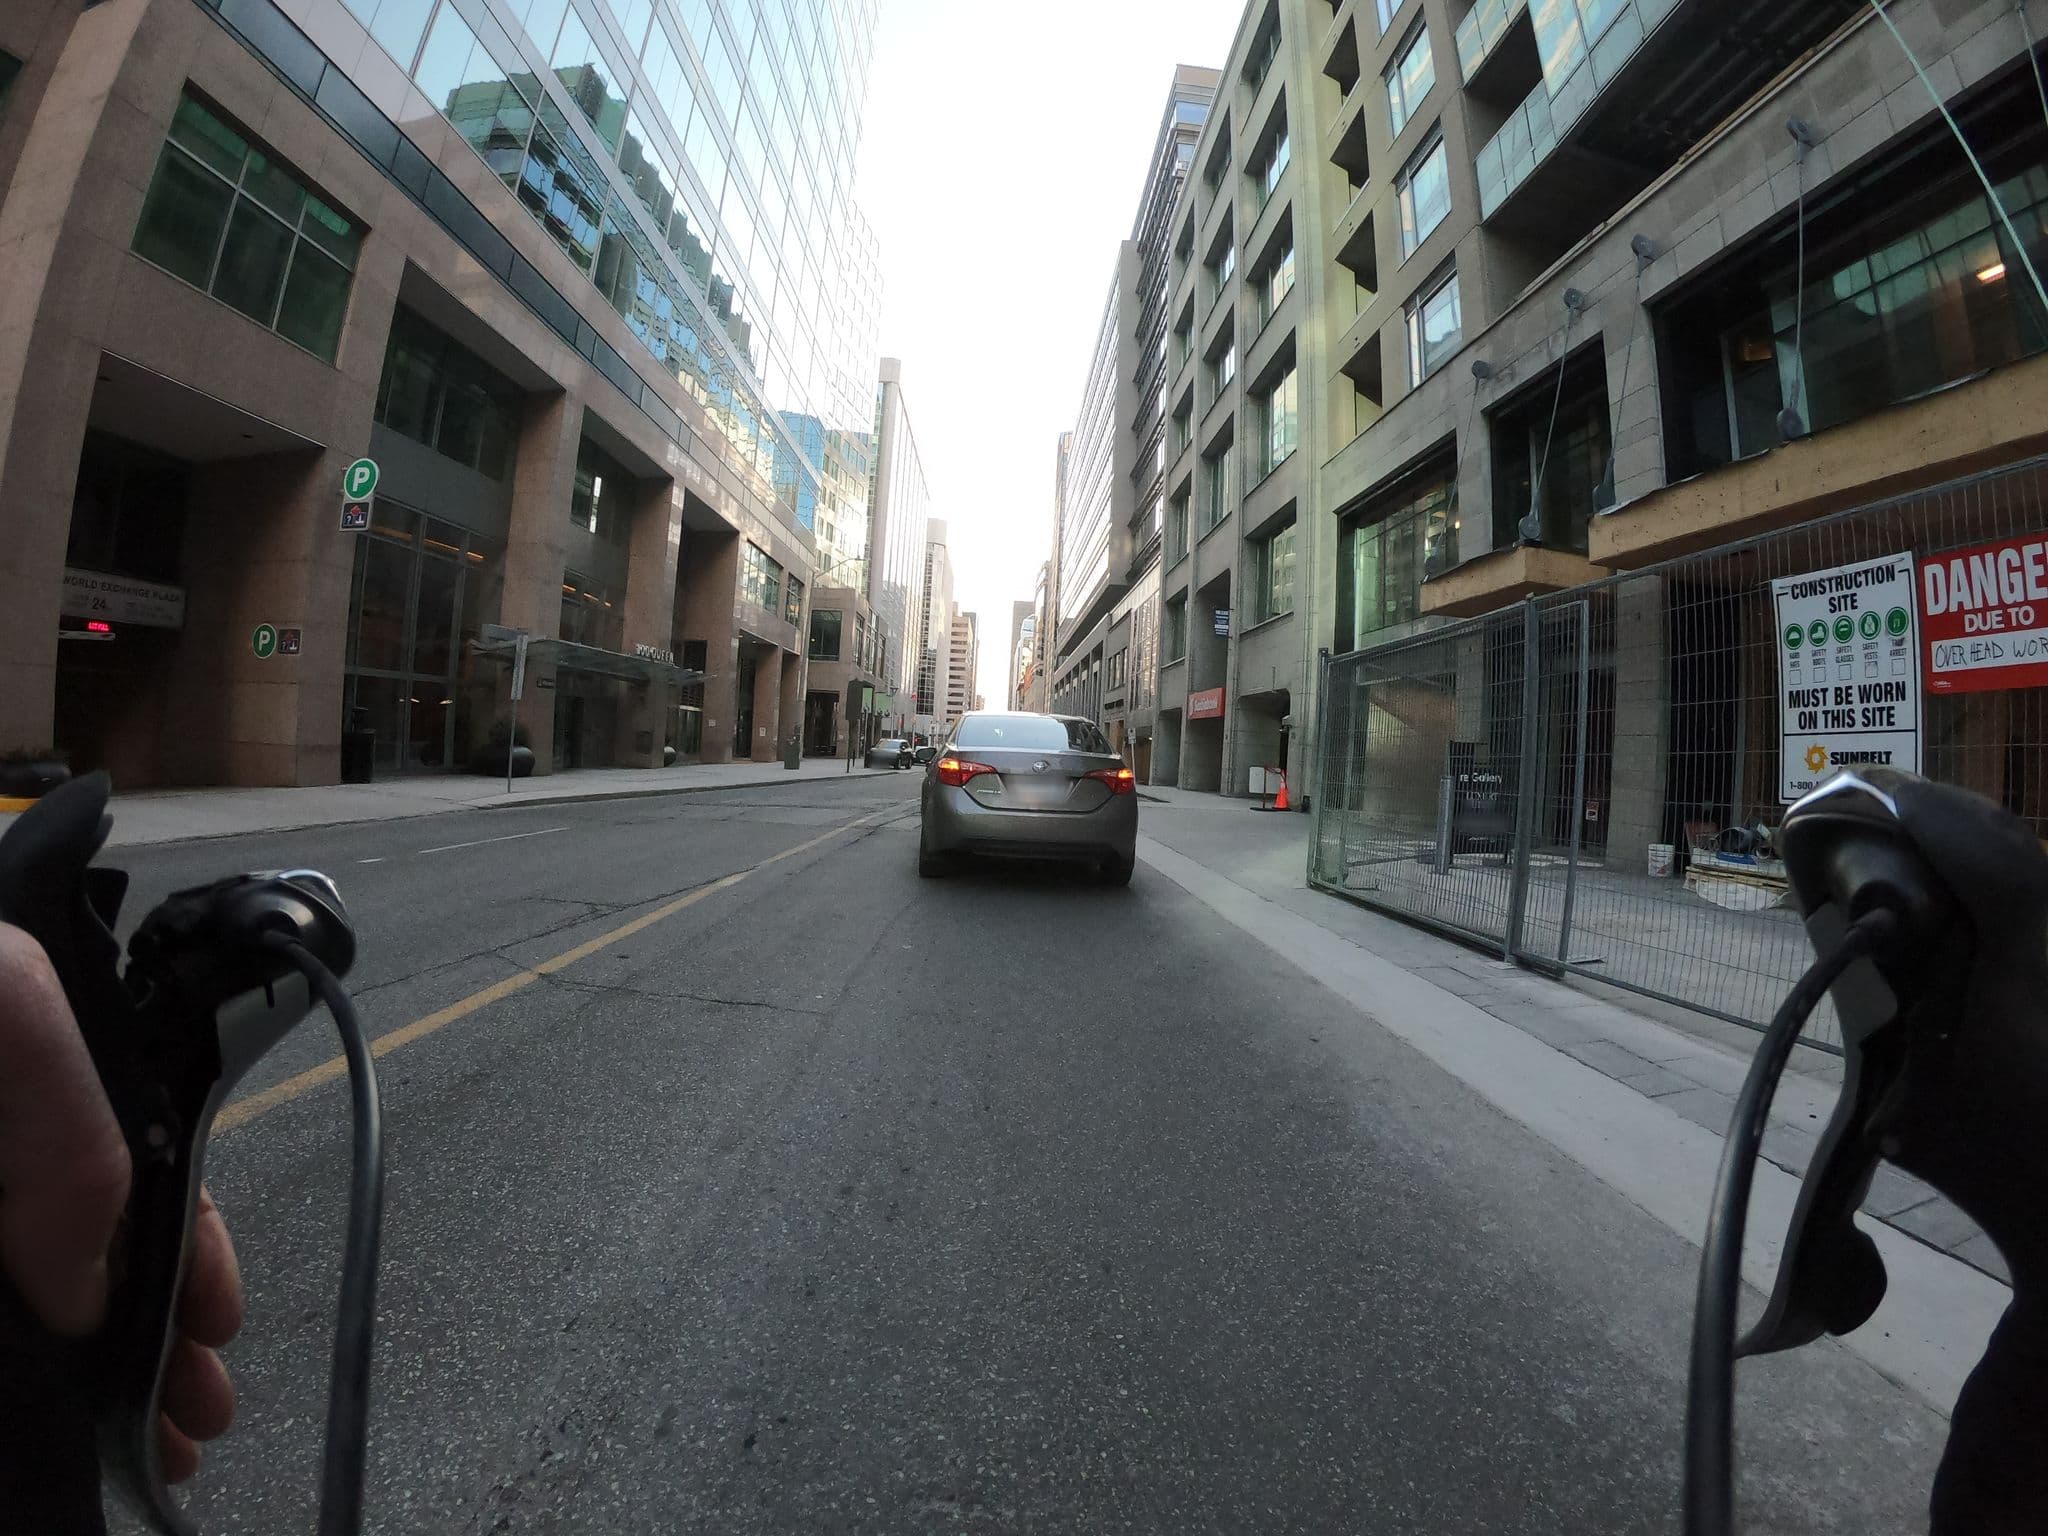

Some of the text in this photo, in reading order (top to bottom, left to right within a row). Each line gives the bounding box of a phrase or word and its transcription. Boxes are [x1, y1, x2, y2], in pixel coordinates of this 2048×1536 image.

[352, 467, 370, 492] P
[63, 575, 98, 590] WORLD
[101, 582, 150, 599] EXCHANGE
[1791, 565, 1895, 600] CONSTRUCTION
[1924, 541, 2048, 616] DANGE
[92, 597, 107, 610] 24
[1829, 593, 1858, 613] SITE
[1964, 606, 2034, 632] DUE TO
[258, 630, 270, 650] P
[1788, 681, 1906, 708] MUST BE WORN
[1798, 706, 1895, 730] ON THIS SITE
[1830, 751, 1892, 765] SUNBELT
[1472, 772, 1502, 784] Gallery
